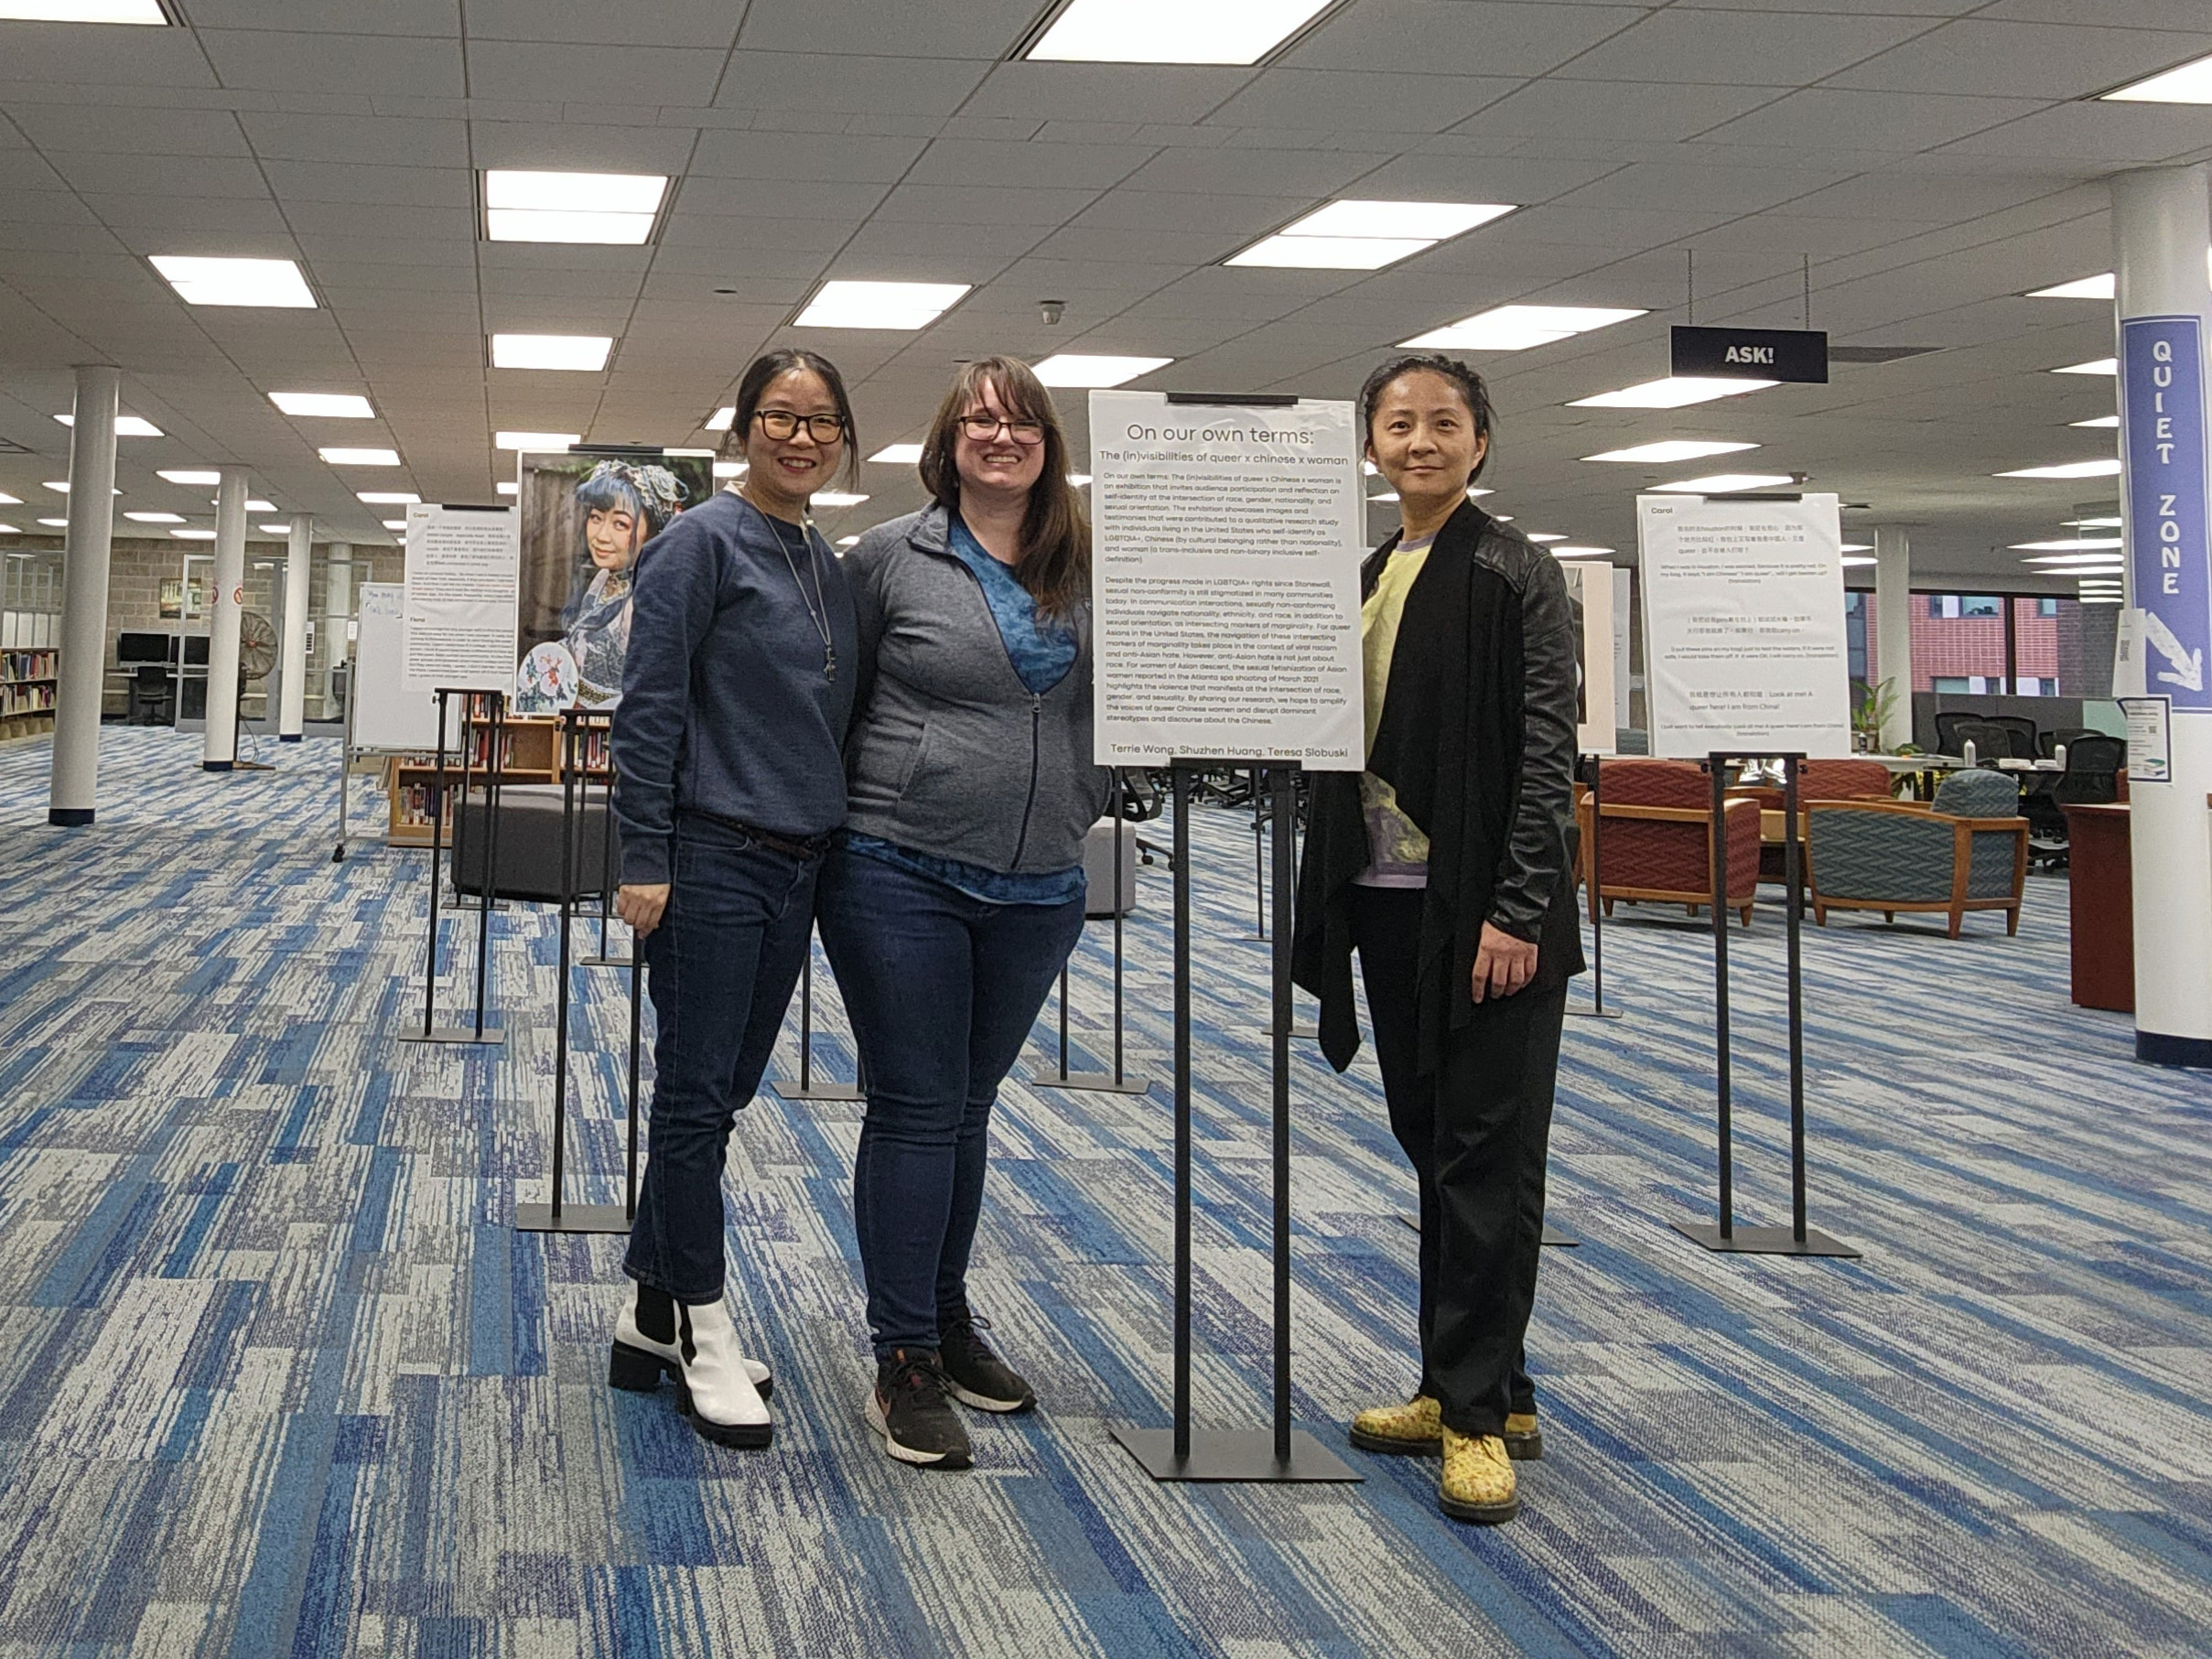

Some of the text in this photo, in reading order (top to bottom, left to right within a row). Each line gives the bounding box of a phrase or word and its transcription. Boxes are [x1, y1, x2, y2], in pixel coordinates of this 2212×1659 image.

[1725, 346, 1775, 364] ASK!
[1127, 424, 1315, 444] On our own terms:
[1099, 450, 1119, 460] The
[1123, 451, 1193, 462] (in)visibilities
[1196, 453, 1206, 461] of
[1210, 455, 1241, 463] queer
[1253, 454, 1295, 463] chinese
[2153, 340, 2180, 596] QUIET ZONE
[1110, 743, 1347, 757] Terrie Wong, Shuzhen Huang, Teresa Slobuski
